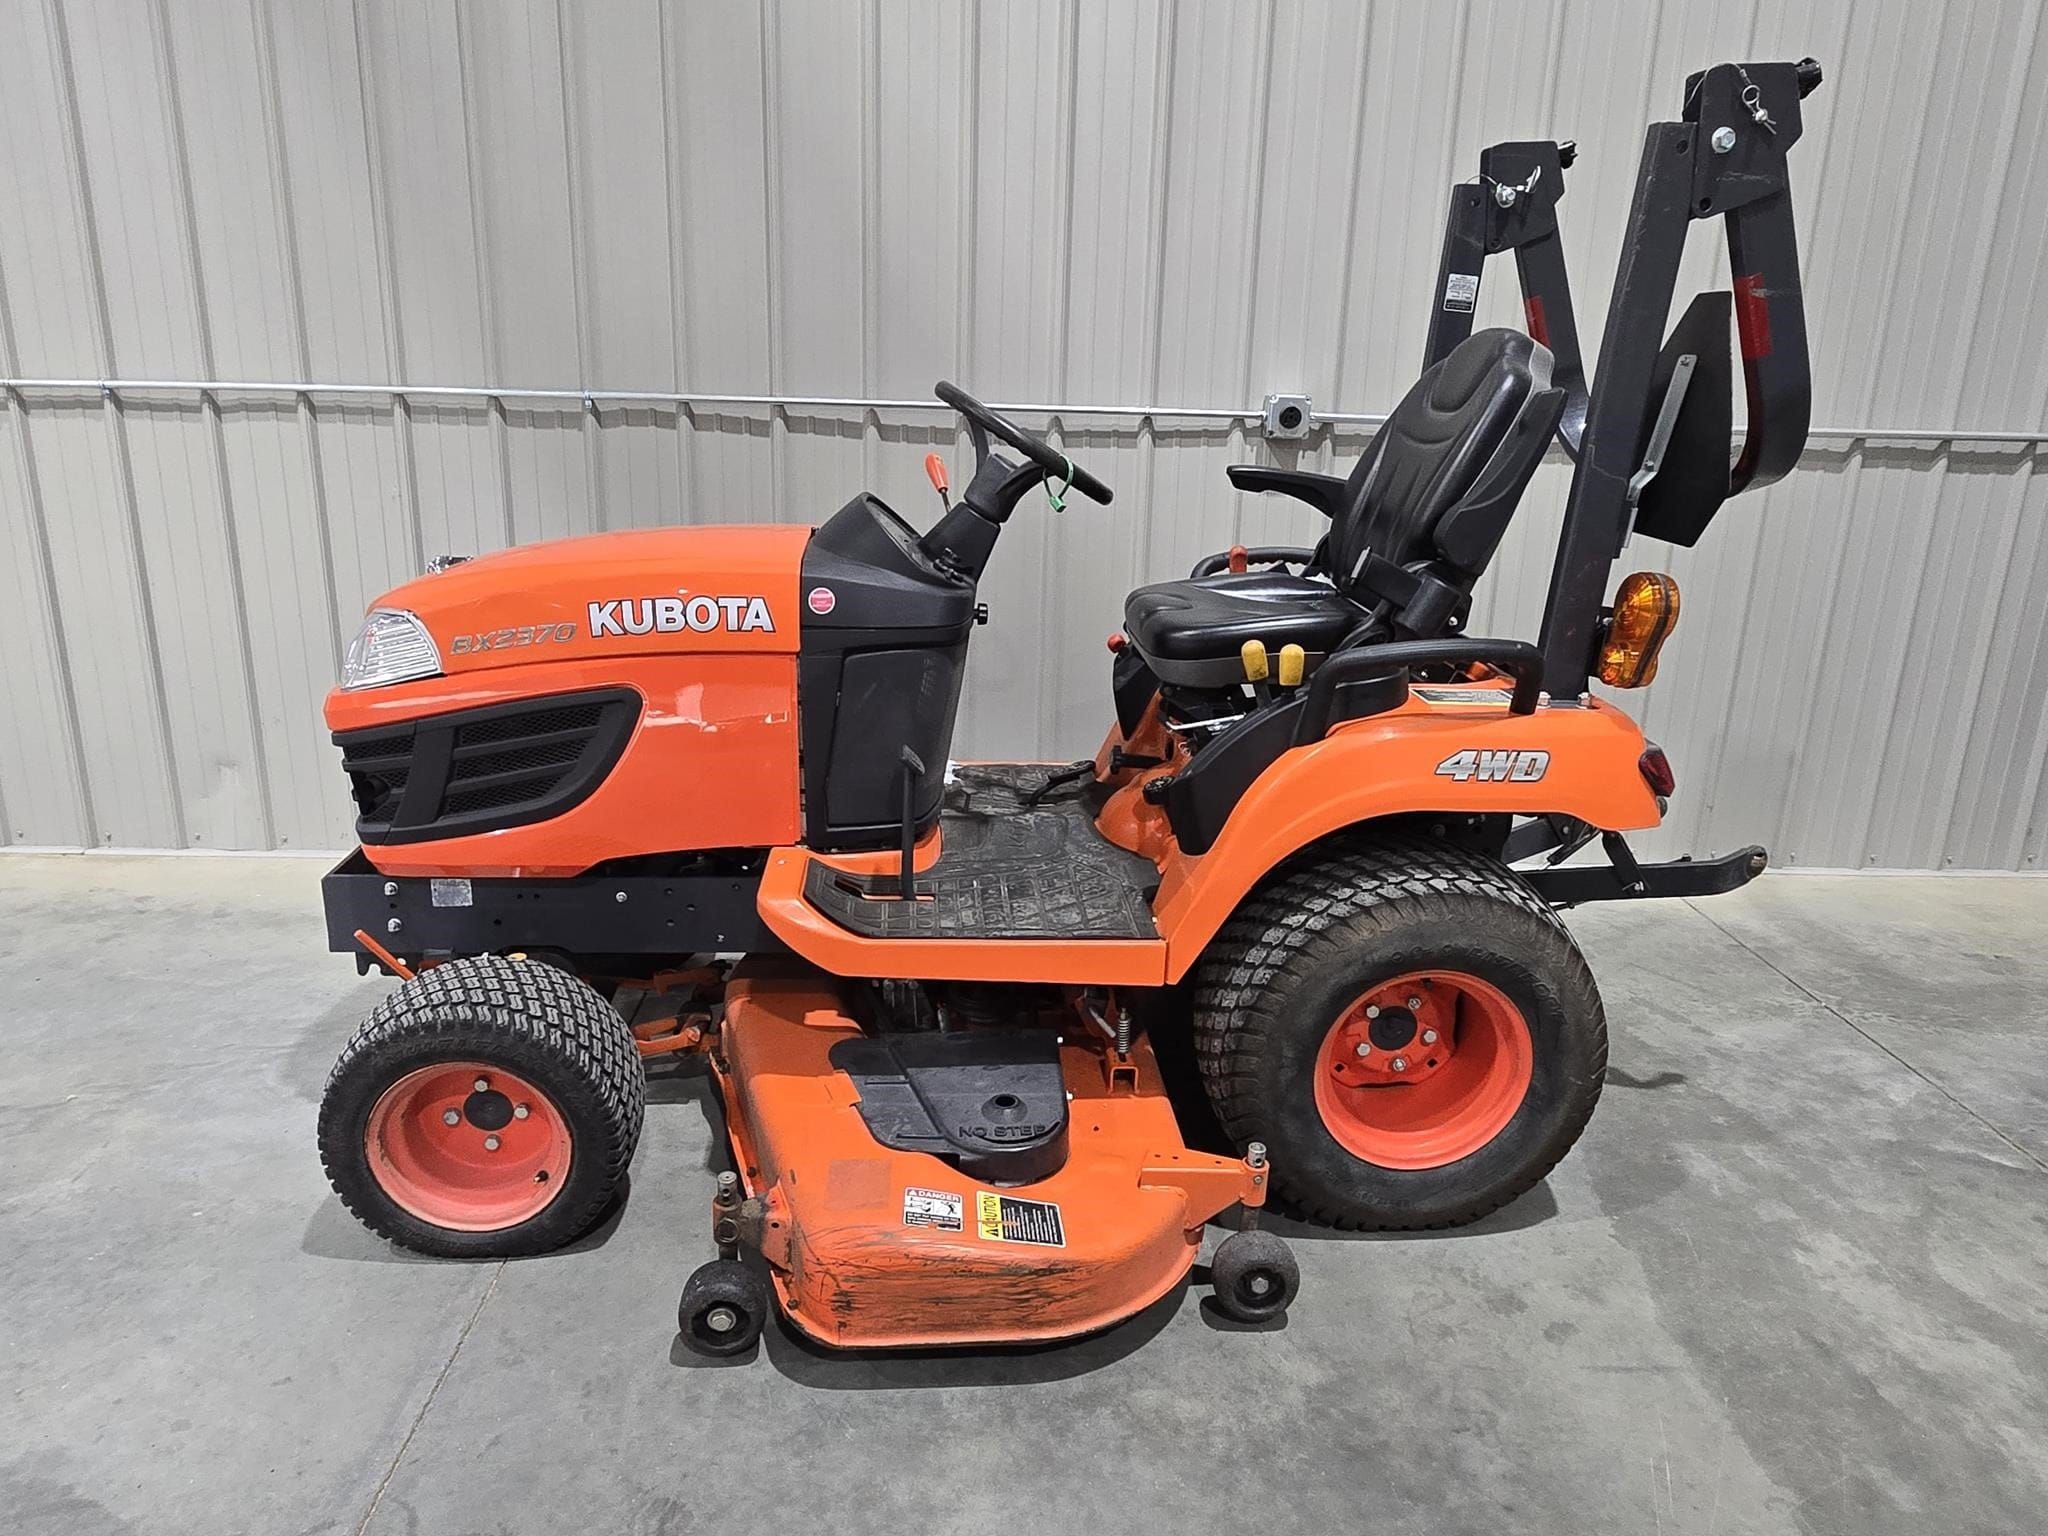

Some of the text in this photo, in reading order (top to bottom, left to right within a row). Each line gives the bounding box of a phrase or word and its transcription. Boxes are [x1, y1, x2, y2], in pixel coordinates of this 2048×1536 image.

[588, 595, 776, 638] KUBOTA
[451, 622, 577, 655] BX2370
[1434, 749, 1551, 783] 4WD
[959, 1124, 1046, 1138] NO STEP
[918, 1190, 960, 1202] DANGER
